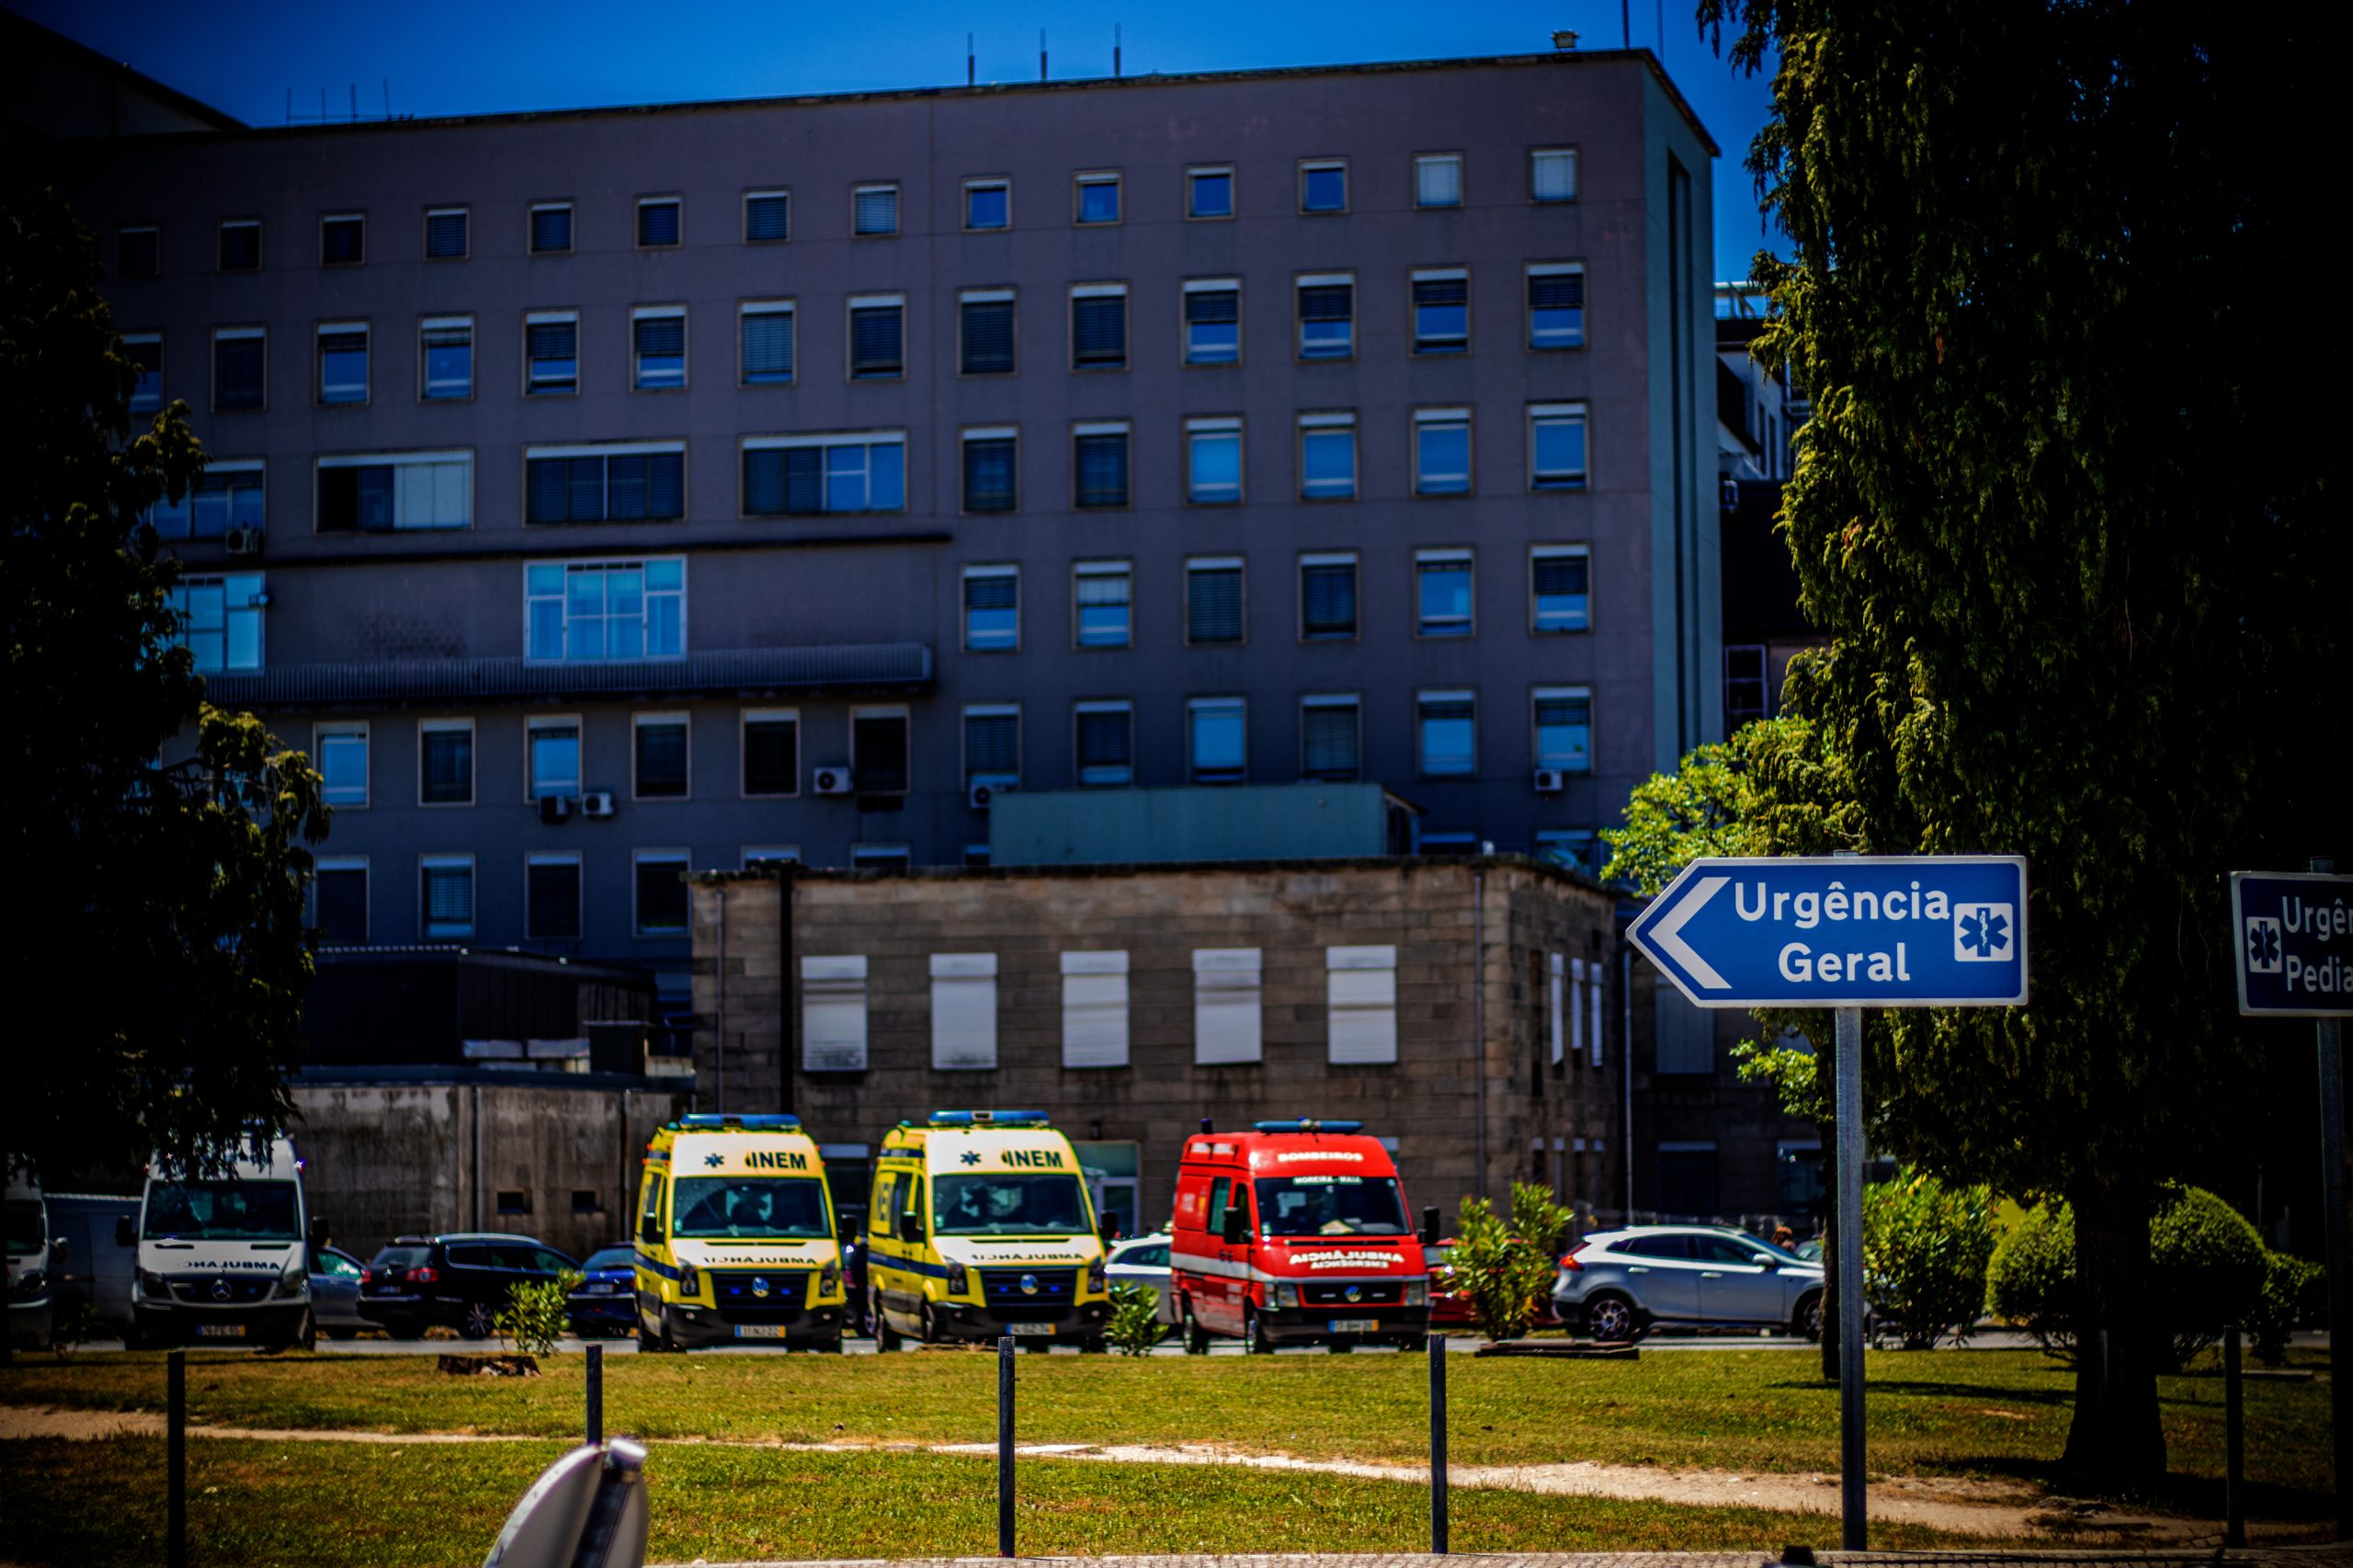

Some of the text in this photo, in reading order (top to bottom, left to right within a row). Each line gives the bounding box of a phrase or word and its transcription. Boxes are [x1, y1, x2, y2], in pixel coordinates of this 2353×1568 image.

[1734, 881, 1950, 929] Urgência
[1778, 941, 1911, 983] Geral
[752, 1151, 808, 1171] INEM
[1006, 1150, 1064, 1168] INEM
[1277, 1152, 1364, 1163] BOMBEIROS
